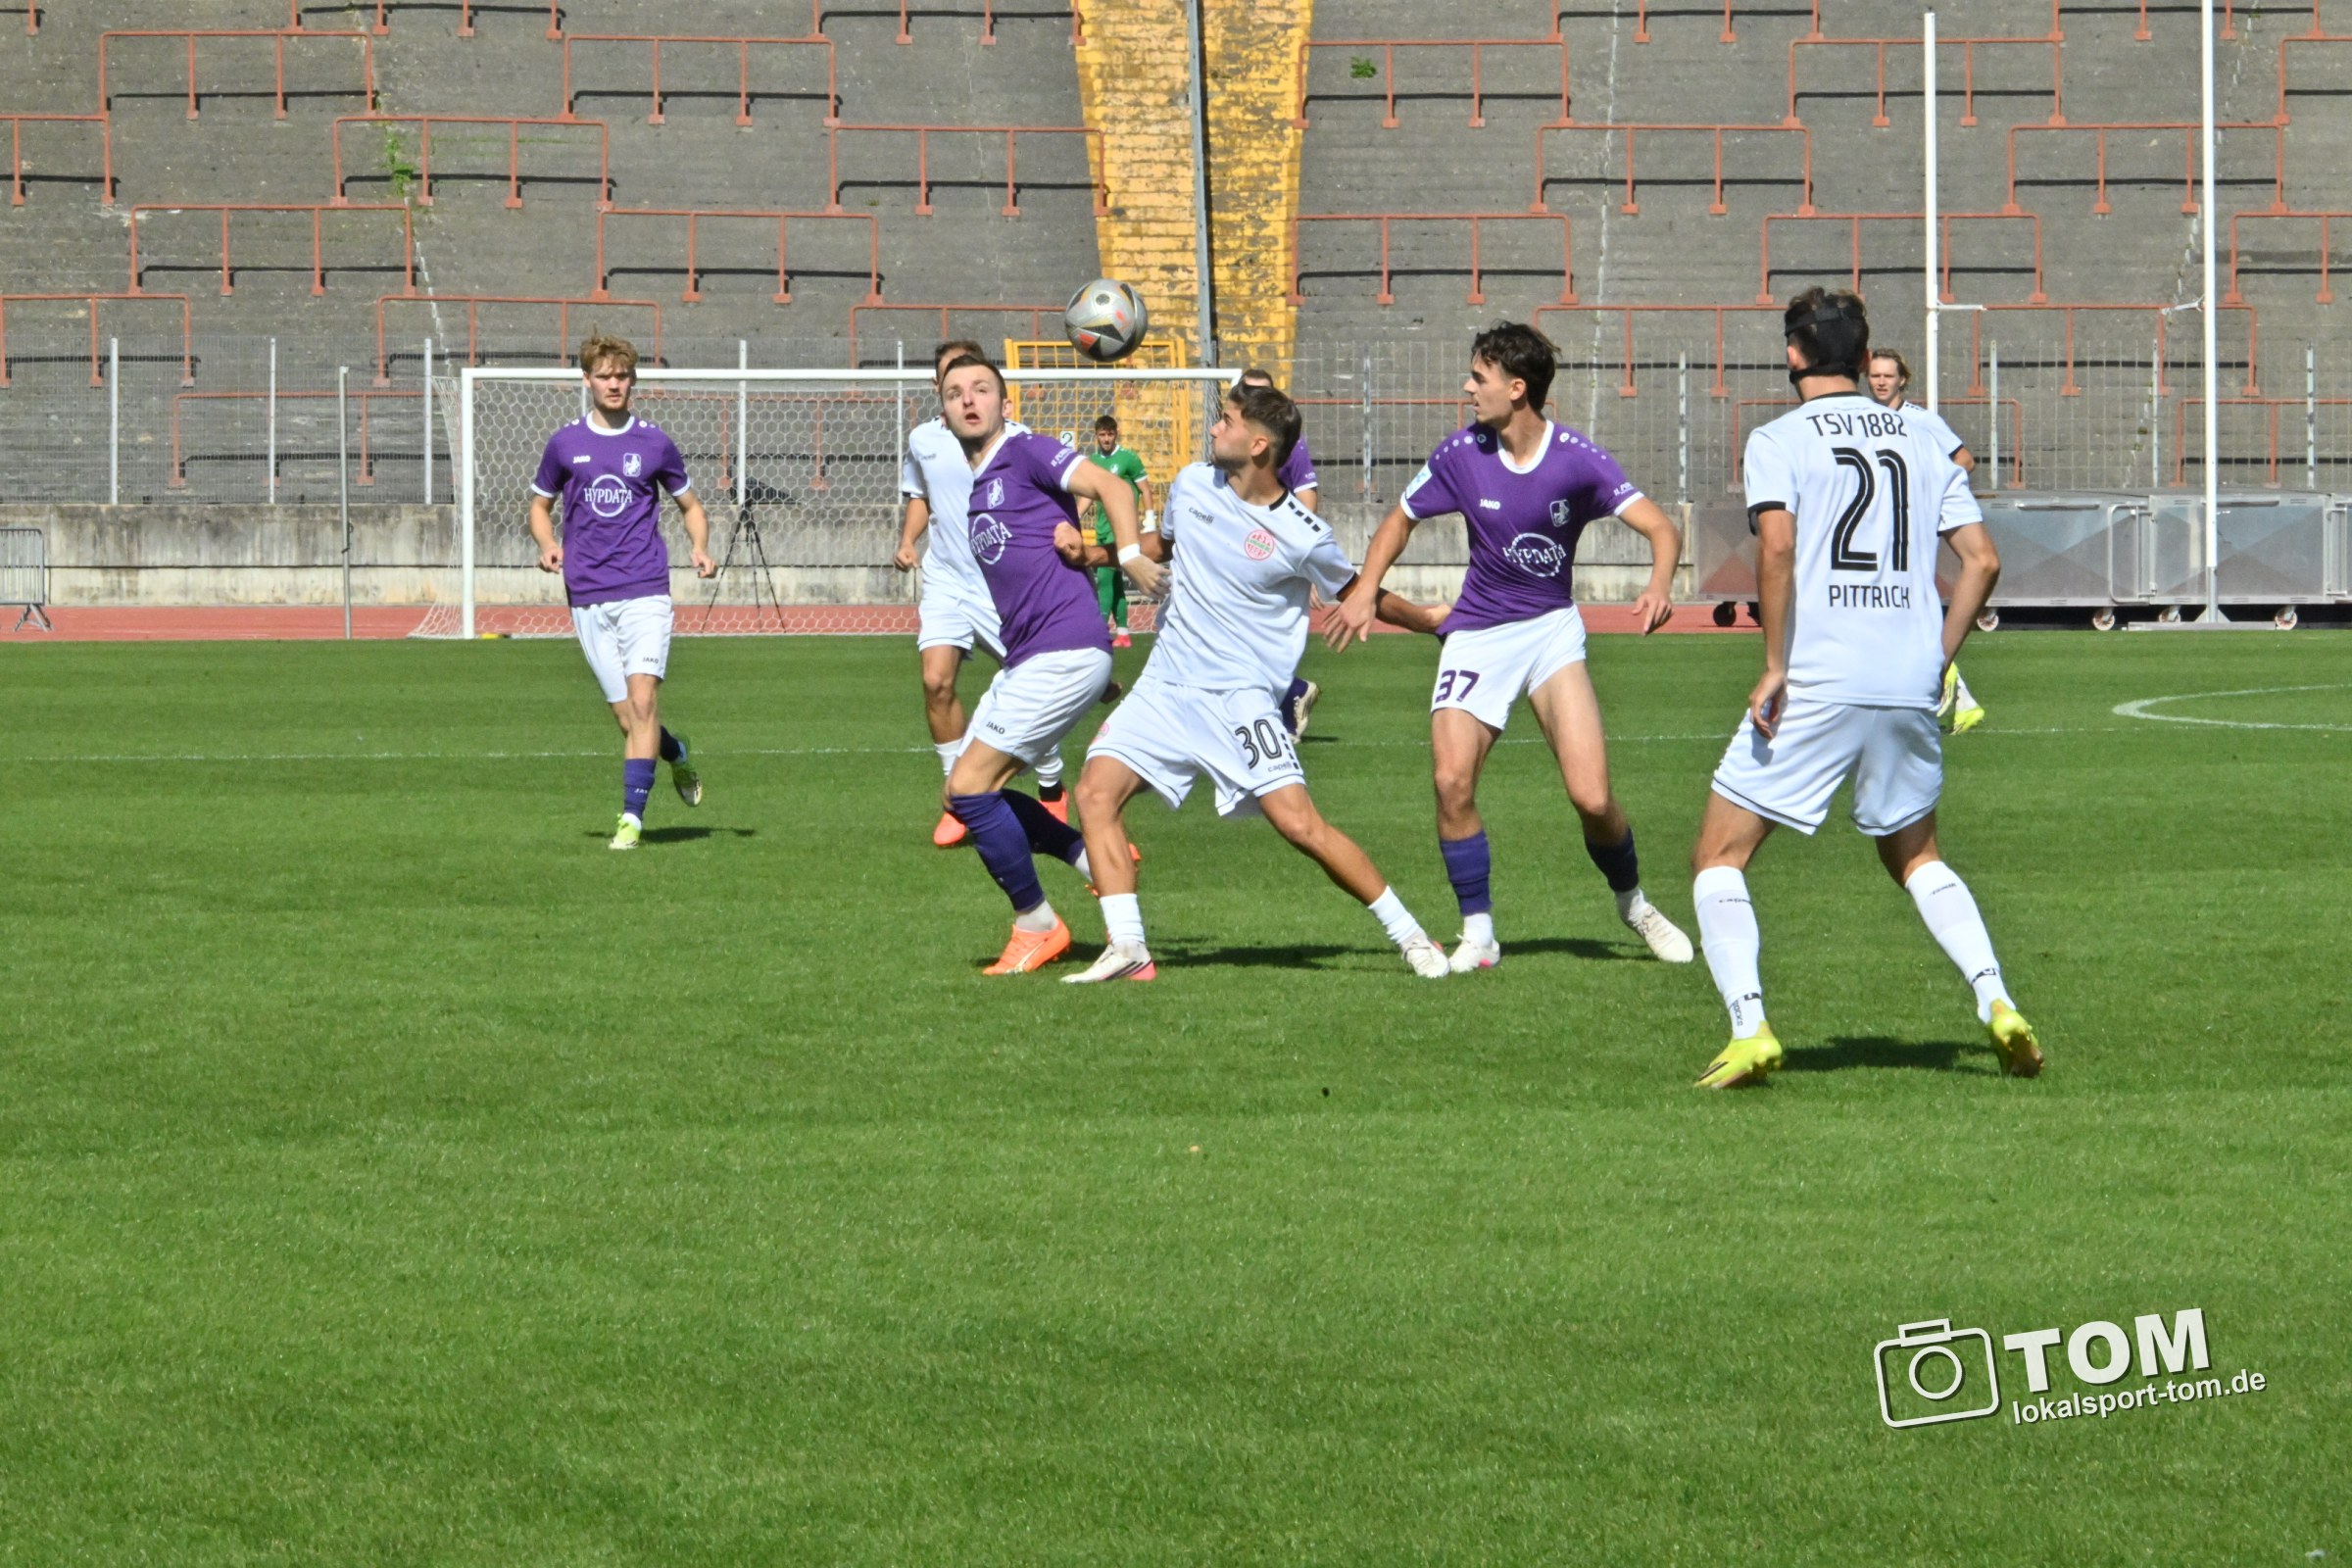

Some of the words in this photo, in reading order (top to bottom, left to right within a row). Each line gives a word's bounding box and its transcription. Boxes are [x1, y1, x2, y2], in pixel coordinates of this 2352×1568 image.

[1806, 413, 1854, 437] TSV
[1856, 412, 1908, 438] 1882
[583, 487, 633, 504] HYPDATA
[1480, 498, 1501, 510] JAKO
[1831, 447, 1909, 572] 21
[1829, 585, 1910, 609] PITTRICH
[1435, 669, 1481, 704] 37
[985, 720, 1005, 735] JAKO
[1235, 718, 1283, 770] 30
